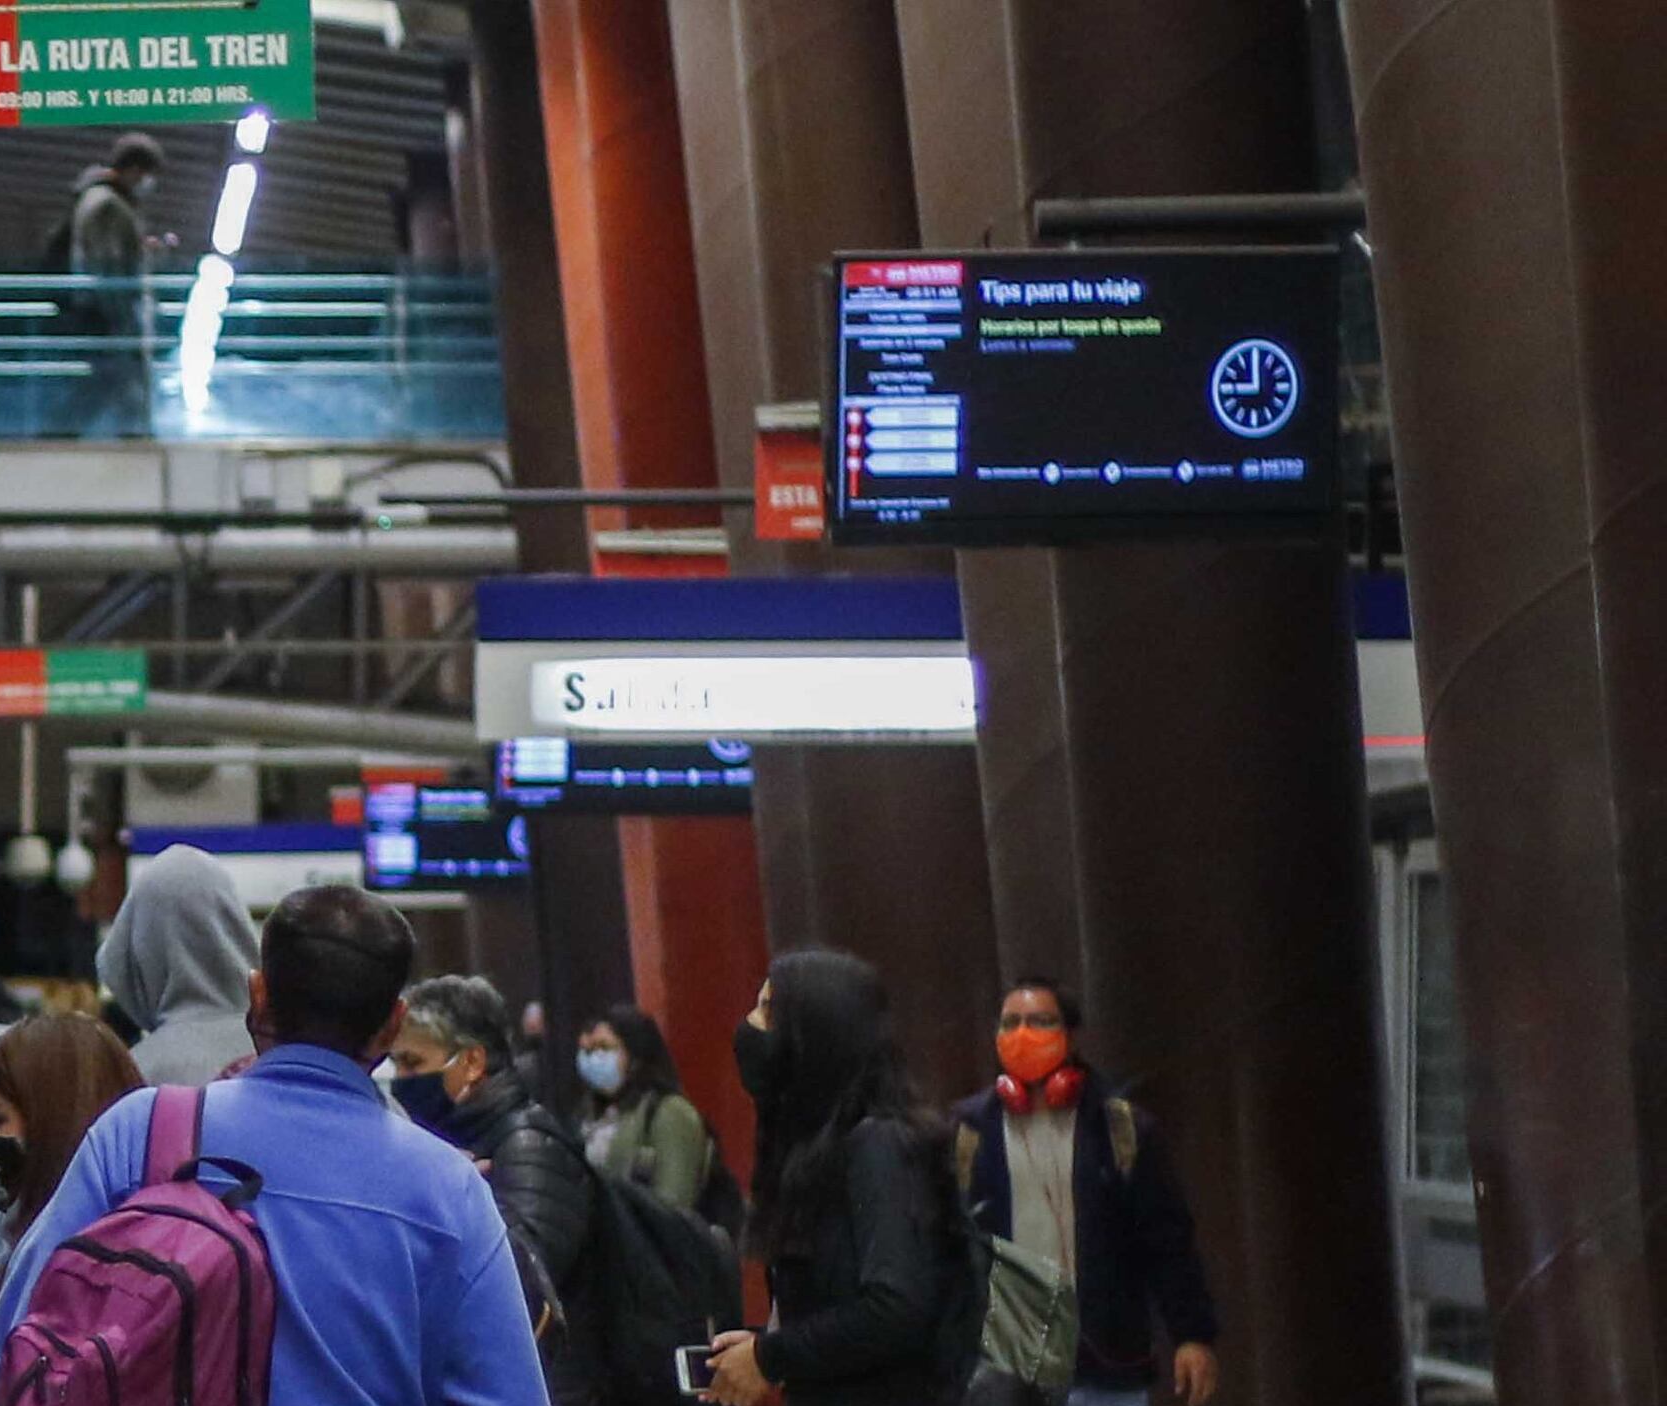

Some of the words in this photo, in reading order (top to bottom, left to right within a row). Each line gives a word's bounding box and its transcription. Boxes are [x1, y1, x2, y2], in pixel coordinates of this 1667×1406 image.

[0, 40, 40, 72] LA
[48, 37, 131, 71] RUTA
[139, 36, 198, 69] DEL
[205, 33, 289, 67] TREN
[88, 89, 101, 106] Y
[152, 88, 165, 105] A
[979, 279, 1022, 306] Tips
[1024, 281, 1069, 306] para
[1072, 279, 1093, 303] tu
[1095, 278, 1142, 306] viaje
